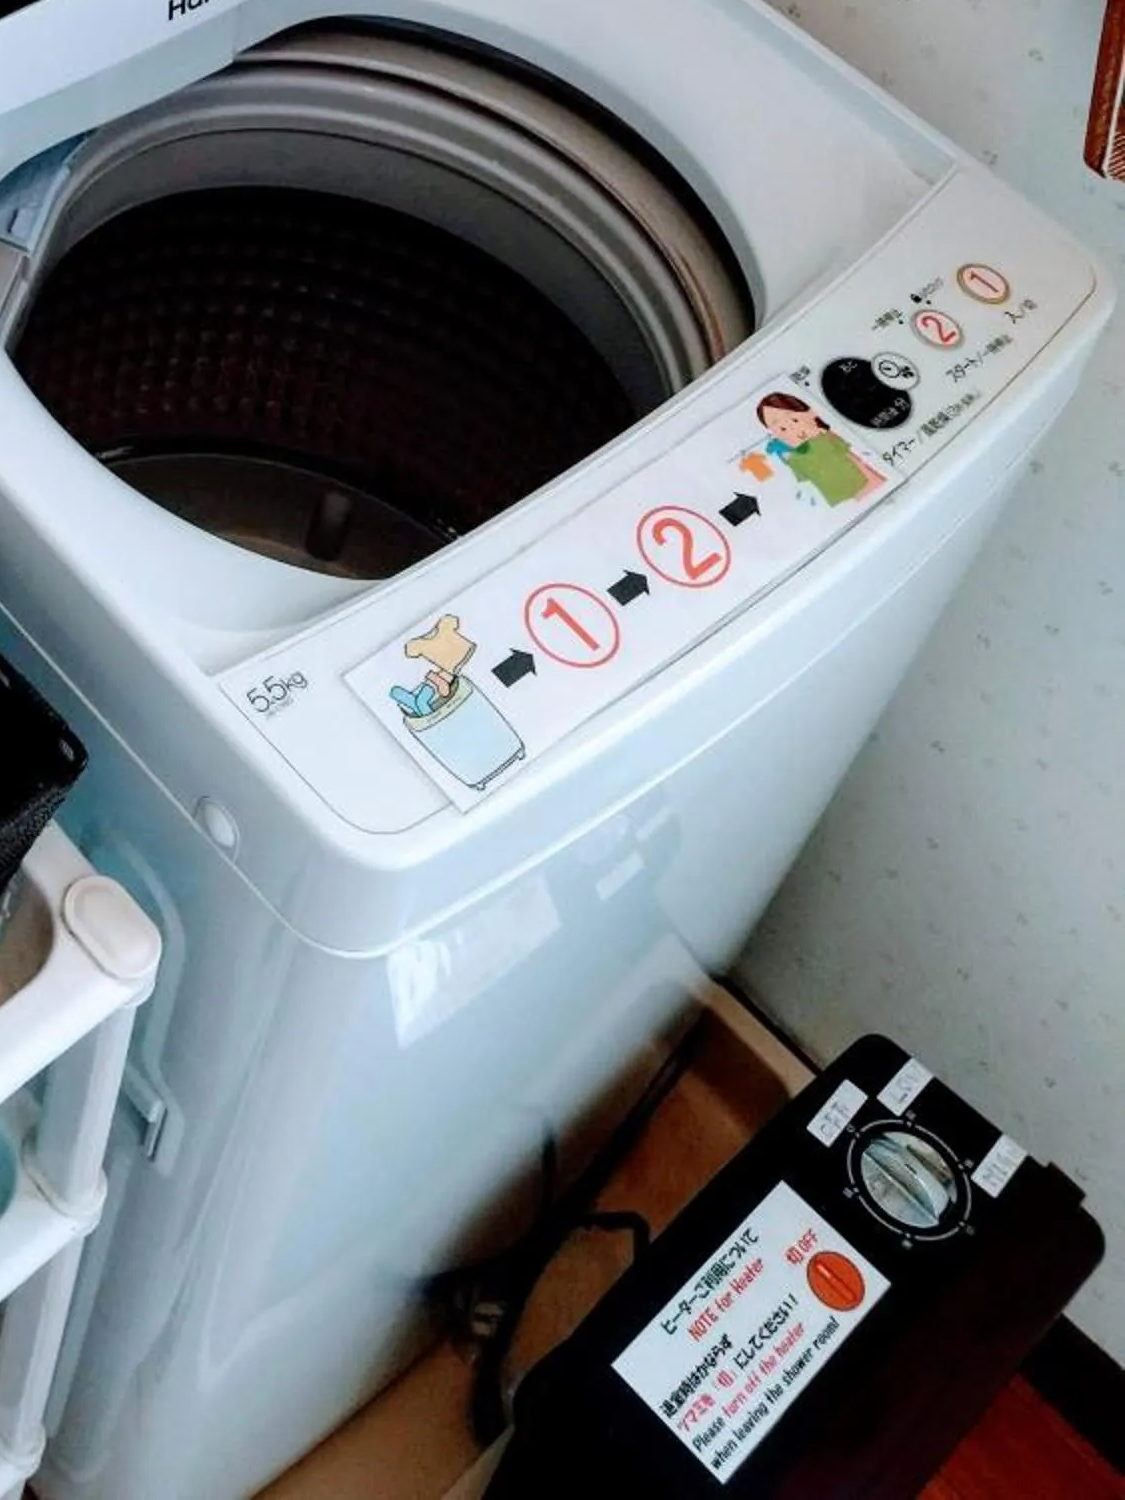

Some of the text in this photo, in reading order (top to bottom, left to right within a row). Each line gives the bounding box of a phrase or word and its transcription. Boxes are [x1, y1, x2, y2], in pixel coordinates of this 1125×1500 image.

[687, 1257, 765, 1343] NOTE for Heater
[691, 1320, 806, 1454] Please turn off the heater
[710, 1440, 739, 1471] when
[731, 1400, 771, 1443] leaving
[762, 1382, 785, 1406] the
[781, 1346, 815, 1387] shower
